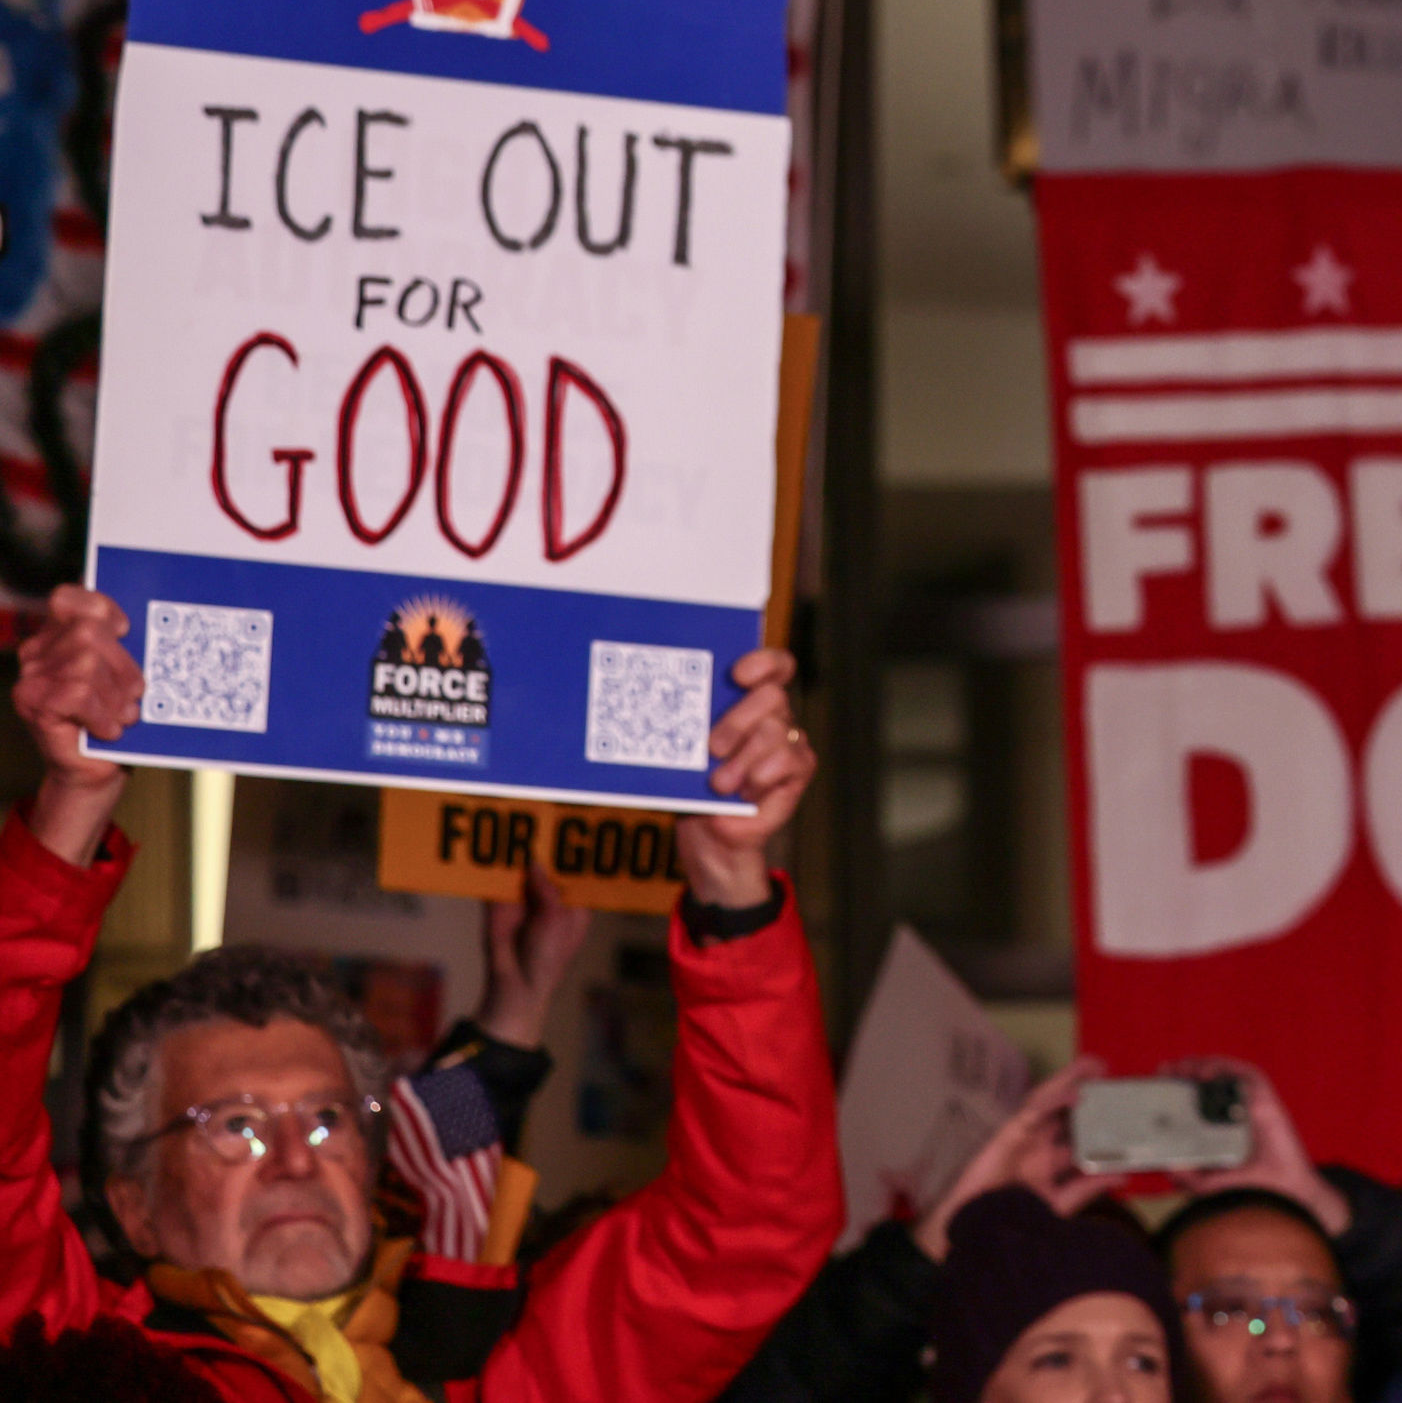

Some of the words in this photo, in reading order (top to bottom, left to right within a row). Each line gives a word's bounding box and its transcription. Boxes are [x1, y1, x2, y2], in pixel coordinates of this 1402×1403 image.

[198, 105, 411, 243] ICE
[479, 118, 736, 268] OUT
[354, 275, 484, 334] FOR
[210, 330, 628, 563] GOOD
[371, 697, 488, 725] MULTIPLIER
[373, 663, 489, 700] FORCE
[438, 803, 536, 866] FOR
